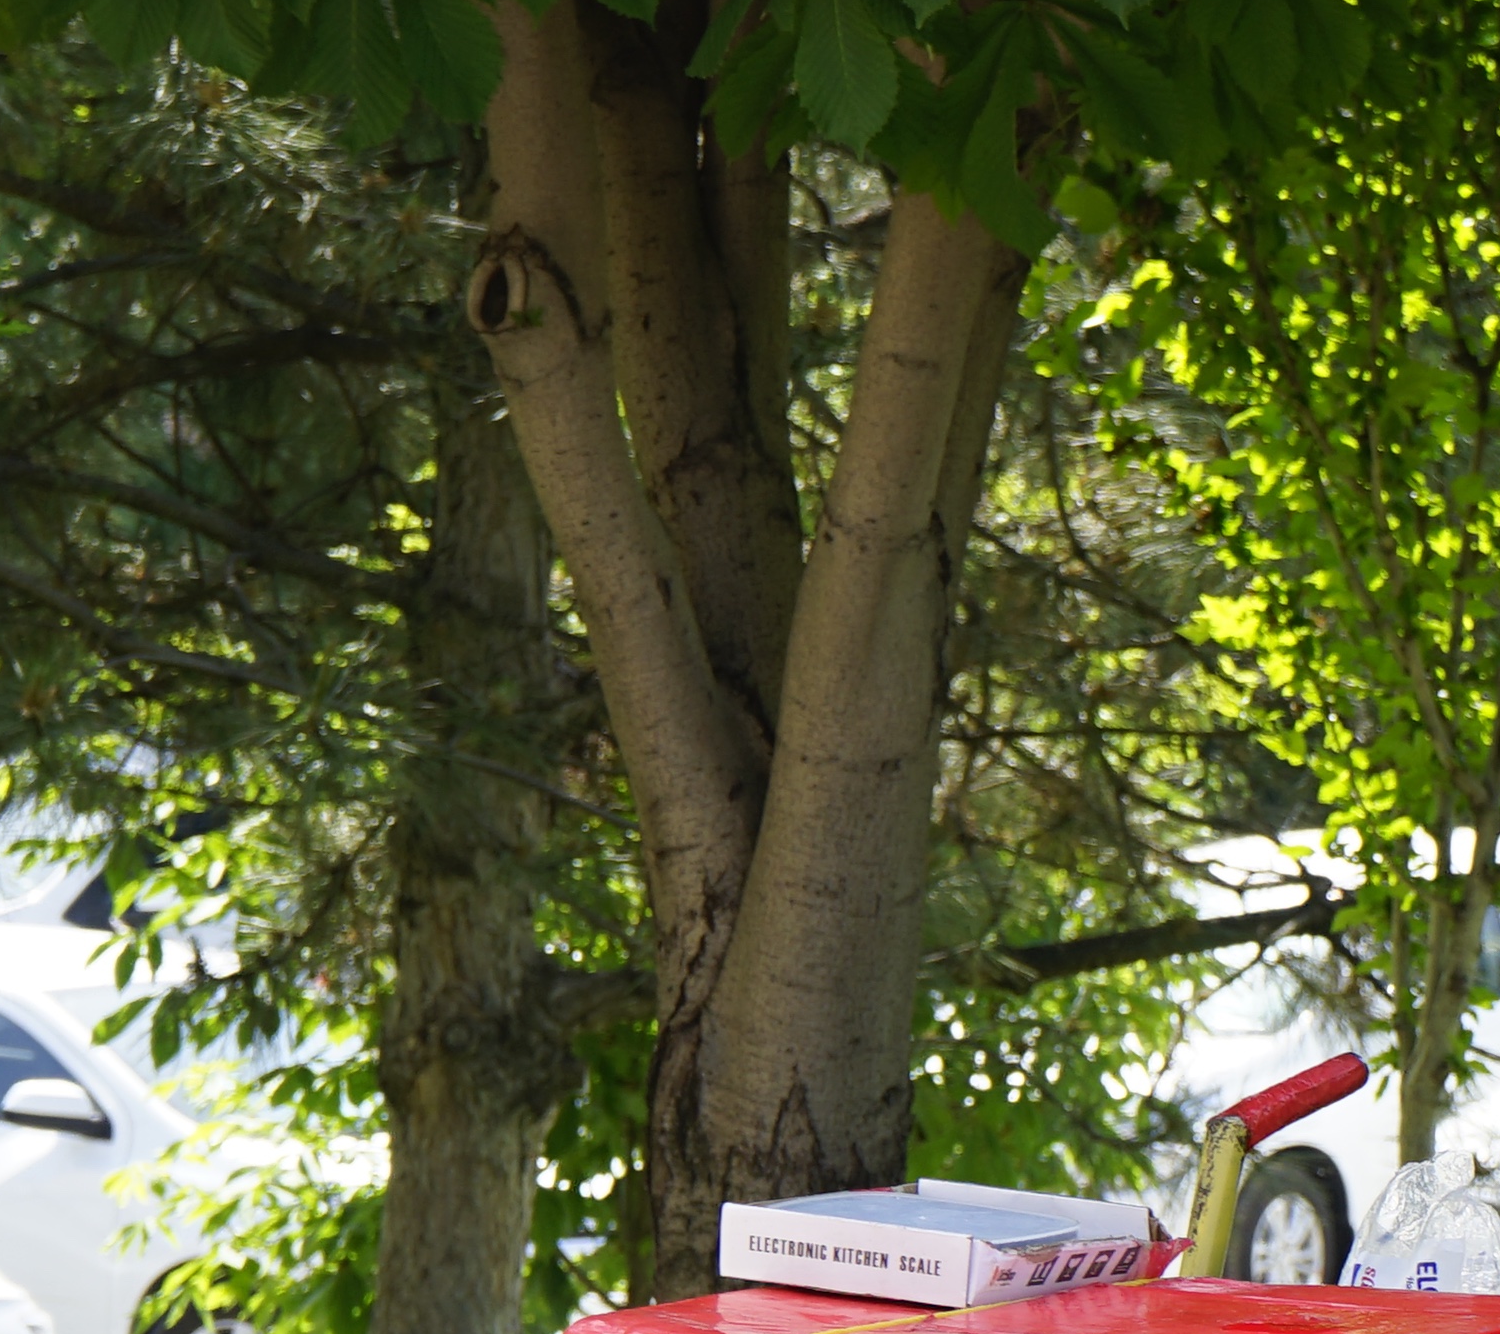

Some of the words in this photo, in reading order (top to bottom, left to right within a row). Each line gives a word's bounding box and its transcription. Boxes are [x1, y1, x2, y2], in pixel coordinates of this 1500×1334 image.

[749, 1235, 828, 1261] ELECTRONIC
[833, 1246, 889, 1269] KITCHEN
[899, 1255, 942, 1276] SCALE
